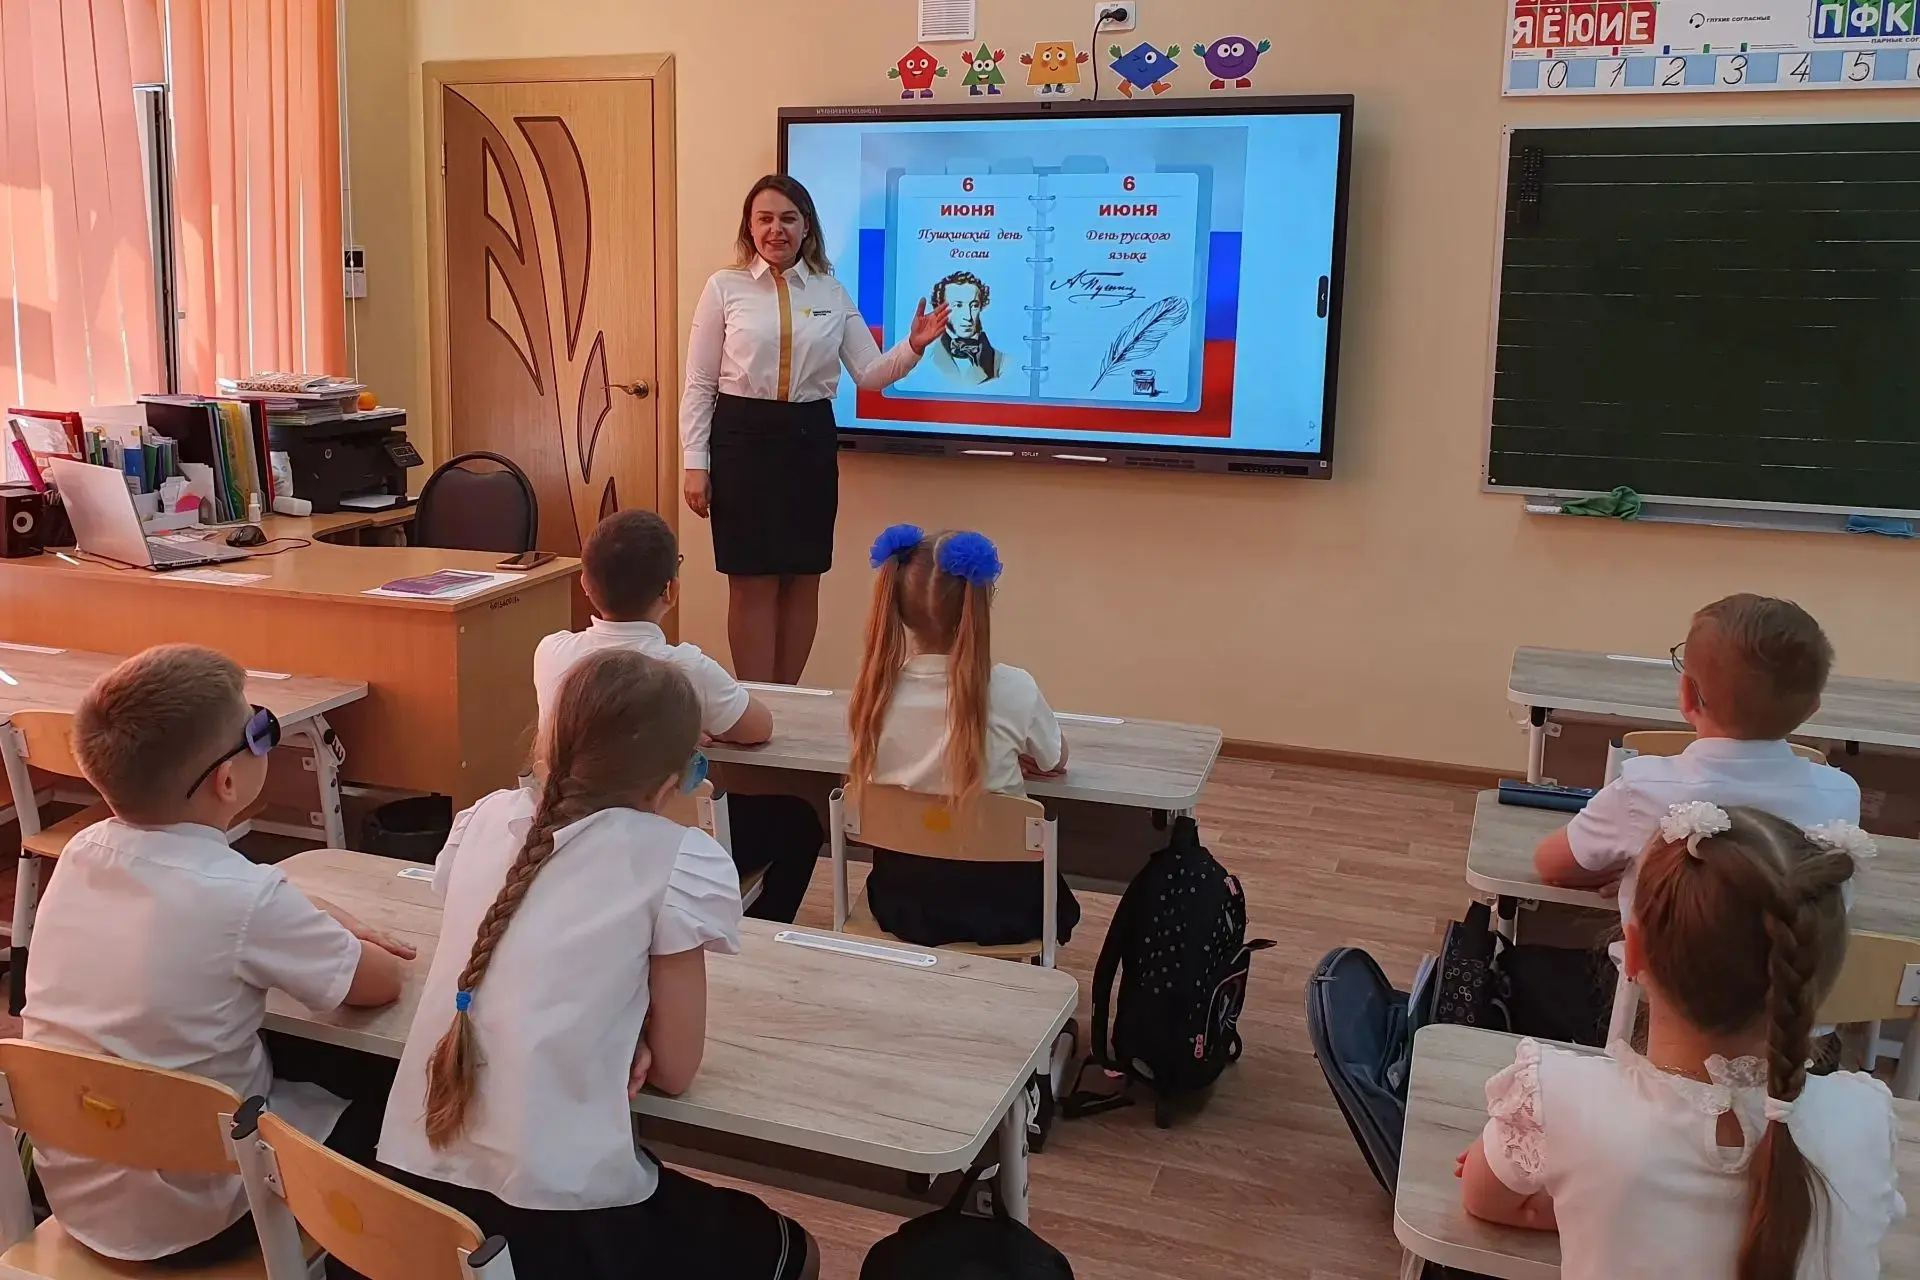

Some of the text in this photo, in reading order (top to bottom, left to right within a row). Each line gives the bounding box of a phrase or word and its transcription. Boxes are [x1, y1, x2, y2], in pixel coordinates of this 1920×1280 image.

[1547, 52, 1877, 88] 0 1 2 3 4 5
[962, 177, 974, 192] 6
[1123, 176, 1135, 192] 6
[918, 228, 1023, 243] Пушкинский день
[1085, 230, 1171, 244] День русского
[950, 248, 990, 259] России
[1107, 251, 1148, 263] языка
